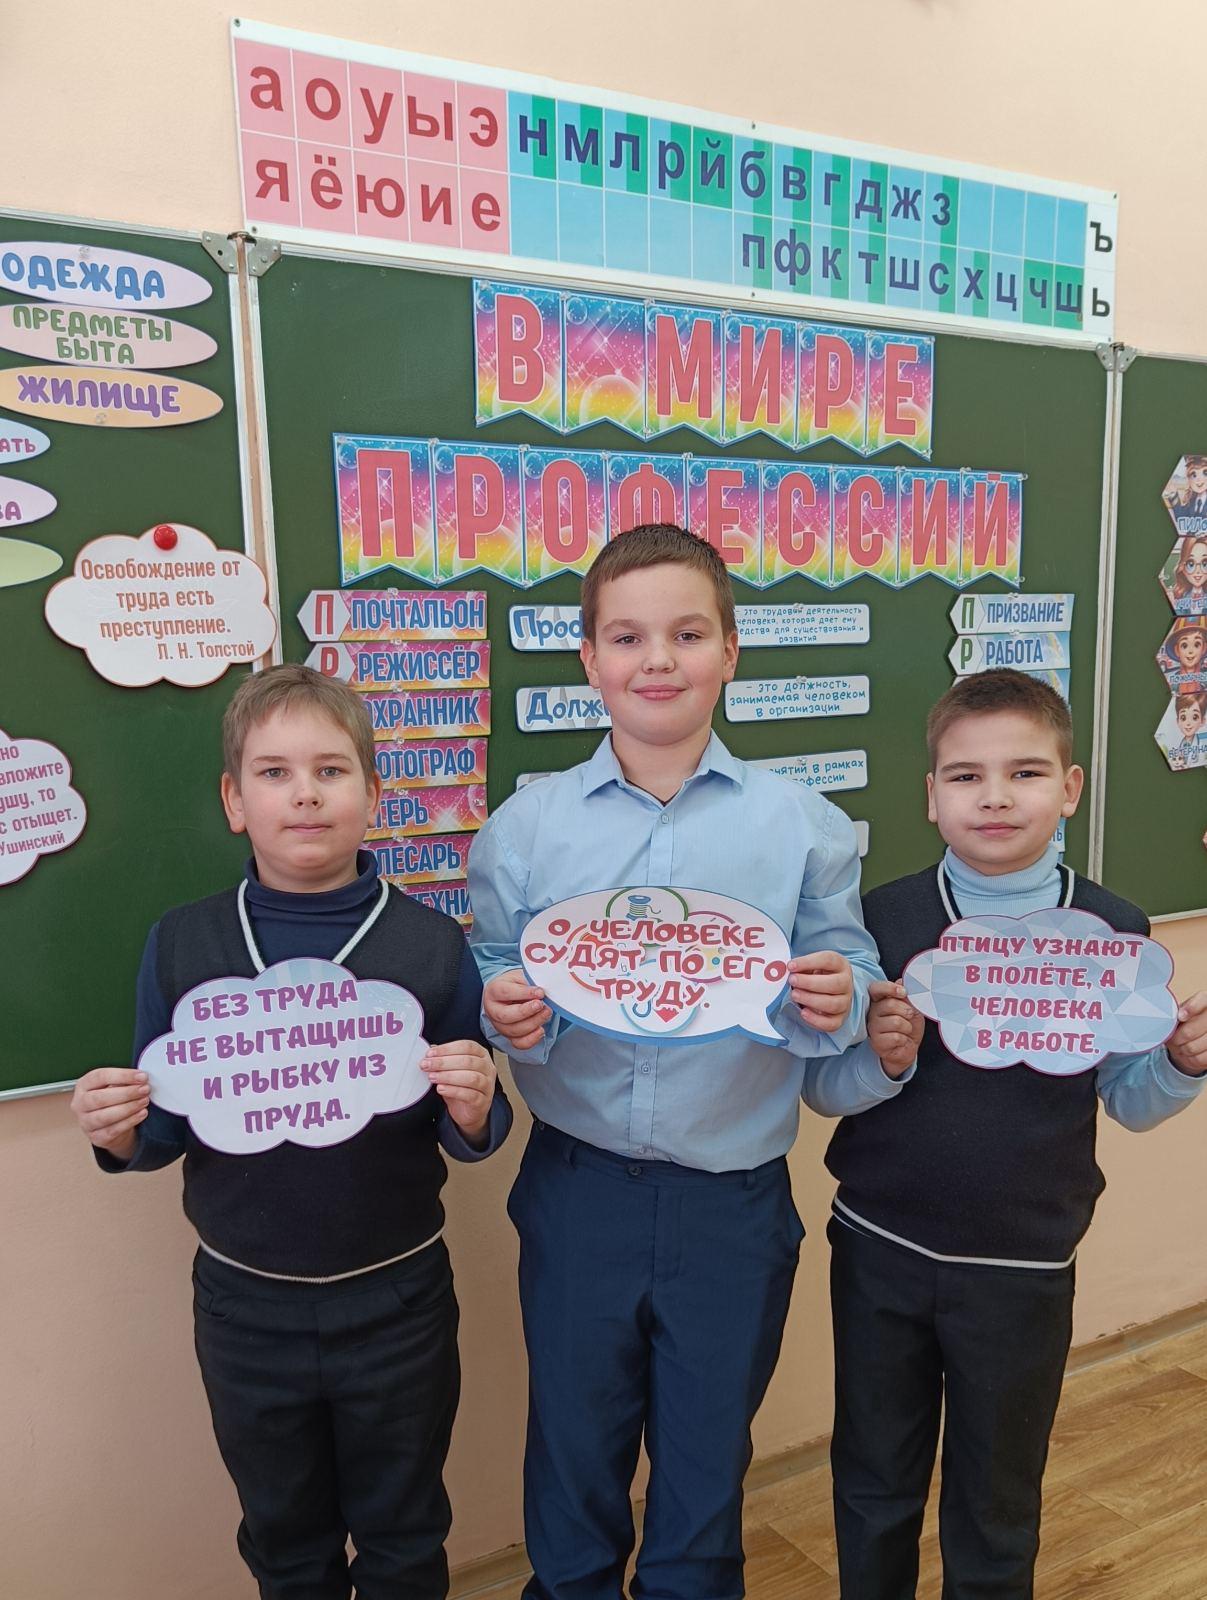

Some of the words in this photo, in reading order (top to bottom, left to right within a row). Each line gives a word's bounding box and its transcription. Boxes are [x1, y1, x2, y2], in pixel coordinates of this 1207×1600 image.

[1, 252, 165, 301] ОДЕЖДА
[13, 306, 173, 342] ПРЕДМЕТЫ
[56, 337, 135, 365] БЫТА
[496, 293, 545, 404] В
[655, 314, 918, 437] МИРЕ
[17, 375, 181, 417] ЖИЛИЩЕ
[0, 438, 36, 453] АТЬ
[356, 450, 1008, 567] ПРОФЕССИЙ
[1177, 517, 1207, 532] ПИЛО
[81, 559, 216, 580] Освобождение
[222, 560, 241, 577] от
[116, 591, 170, 612] труда
[176, 590, 215, 607] есть
[314, 594, 334, 635] П
[351, 599, 485, 631] ПОЧТАЛЬОН
[806, 607, 861, 615] деятельность
[961, 597, 974, 629] П
[987, 602, 1064, 623] ПРИЗВАНИЕ
[100, 618, 231, 641] преступление.
[794, 625, 856, 634] существования
[178, 642, 193, 659] Н.
[197, 640, 255, 658] Толстой
[960, 638, 973, 670] Р
[986, 639, 1043, 665] РАБОТА
[358, 645, 481, 683] РЕЖИССЁР
[730, 693, 799, 706] занимаемая
[805, 690, 867, 702] человеком
[759, 684, 778, 693] это
[0, 746, 19, 760] но
[375, 748, 475, 779] ОТОГРАФ
[825, 760, 864, 773] рамках
[0, 793, 35, 814] ушу,
[38, 788, 56, 802] то
[12, 808, 78, 831] отыщет.
[377, 843, 460, 876] ЛЕСАРЬ
[548, 919, 571, 936] О
[590, 920, 765, 948] ЧЕЛОВЕКЕ
[940, 936, 1026, 958] ПТИЦУ
[1032, 937, 1143, 957] УЗНАЮТ
[524, 943, 641, 970] СУДЯТ
[659, 951, 704, 975] ПО
[723, 956, 787, 982] ЕГО
[965, 965, 980, 983] В
[987, 962, 1092, 990] ПОЛЁТЕ,
[1100, 969, 1115, 988] А
[192, 994, 249, 1021] БЕЗ
[255, 980, 358, 1013] ТРУДА
[596, 978, 710, 1009] ТРУДУ.
[970, 997, 1103, 1020] ЧЕЛОВЕКА
[166, 1037, 208, 1065] НЕ
[215, 1012, 403, 1059] ВЫТАЩИШЬ
[977, 1029, 991, 1048] В
[1000, 1030, 1099, 1054] РАБОТЕ.
[204, 1077, 222, 1100] И
[231, 1058, 339, 1097] РЫБКУ
[348, 1054, 386, 1079] ИЗ
[244, 1098, 350, 1134] ПРУДА.
